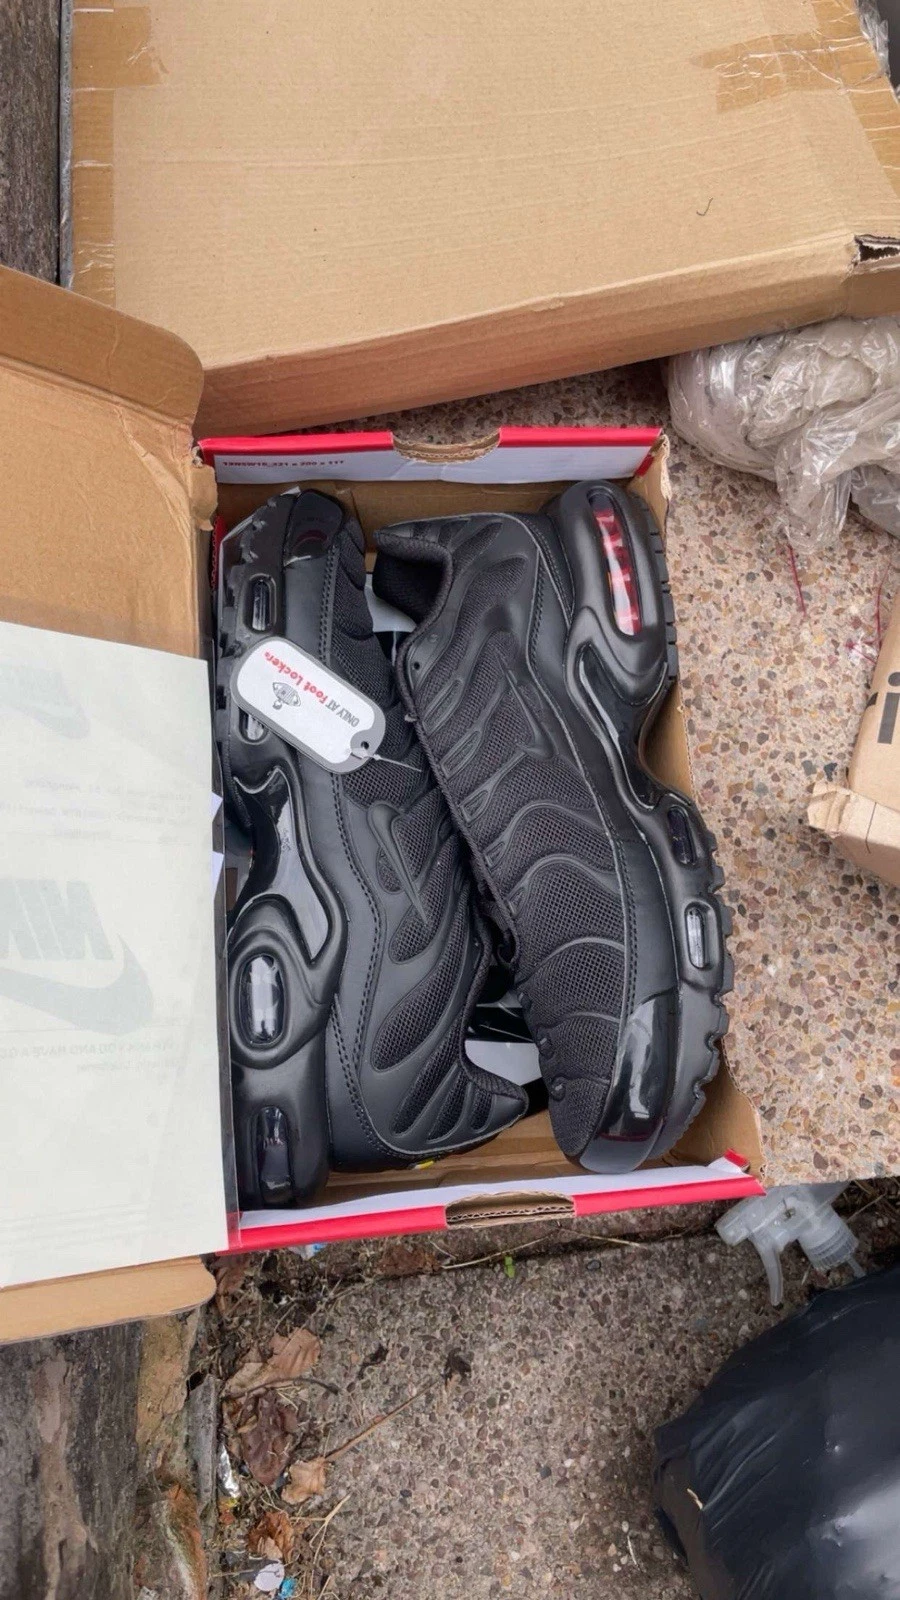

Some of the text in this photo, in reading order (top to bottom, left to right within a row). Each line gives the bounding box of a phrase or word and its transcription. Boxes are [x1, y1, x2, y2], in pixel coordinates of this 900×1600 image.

[303, 683, 328, 704] Foot
[325, 699, 340, 714] AT
[338, 712, 360, 728] ONLY
